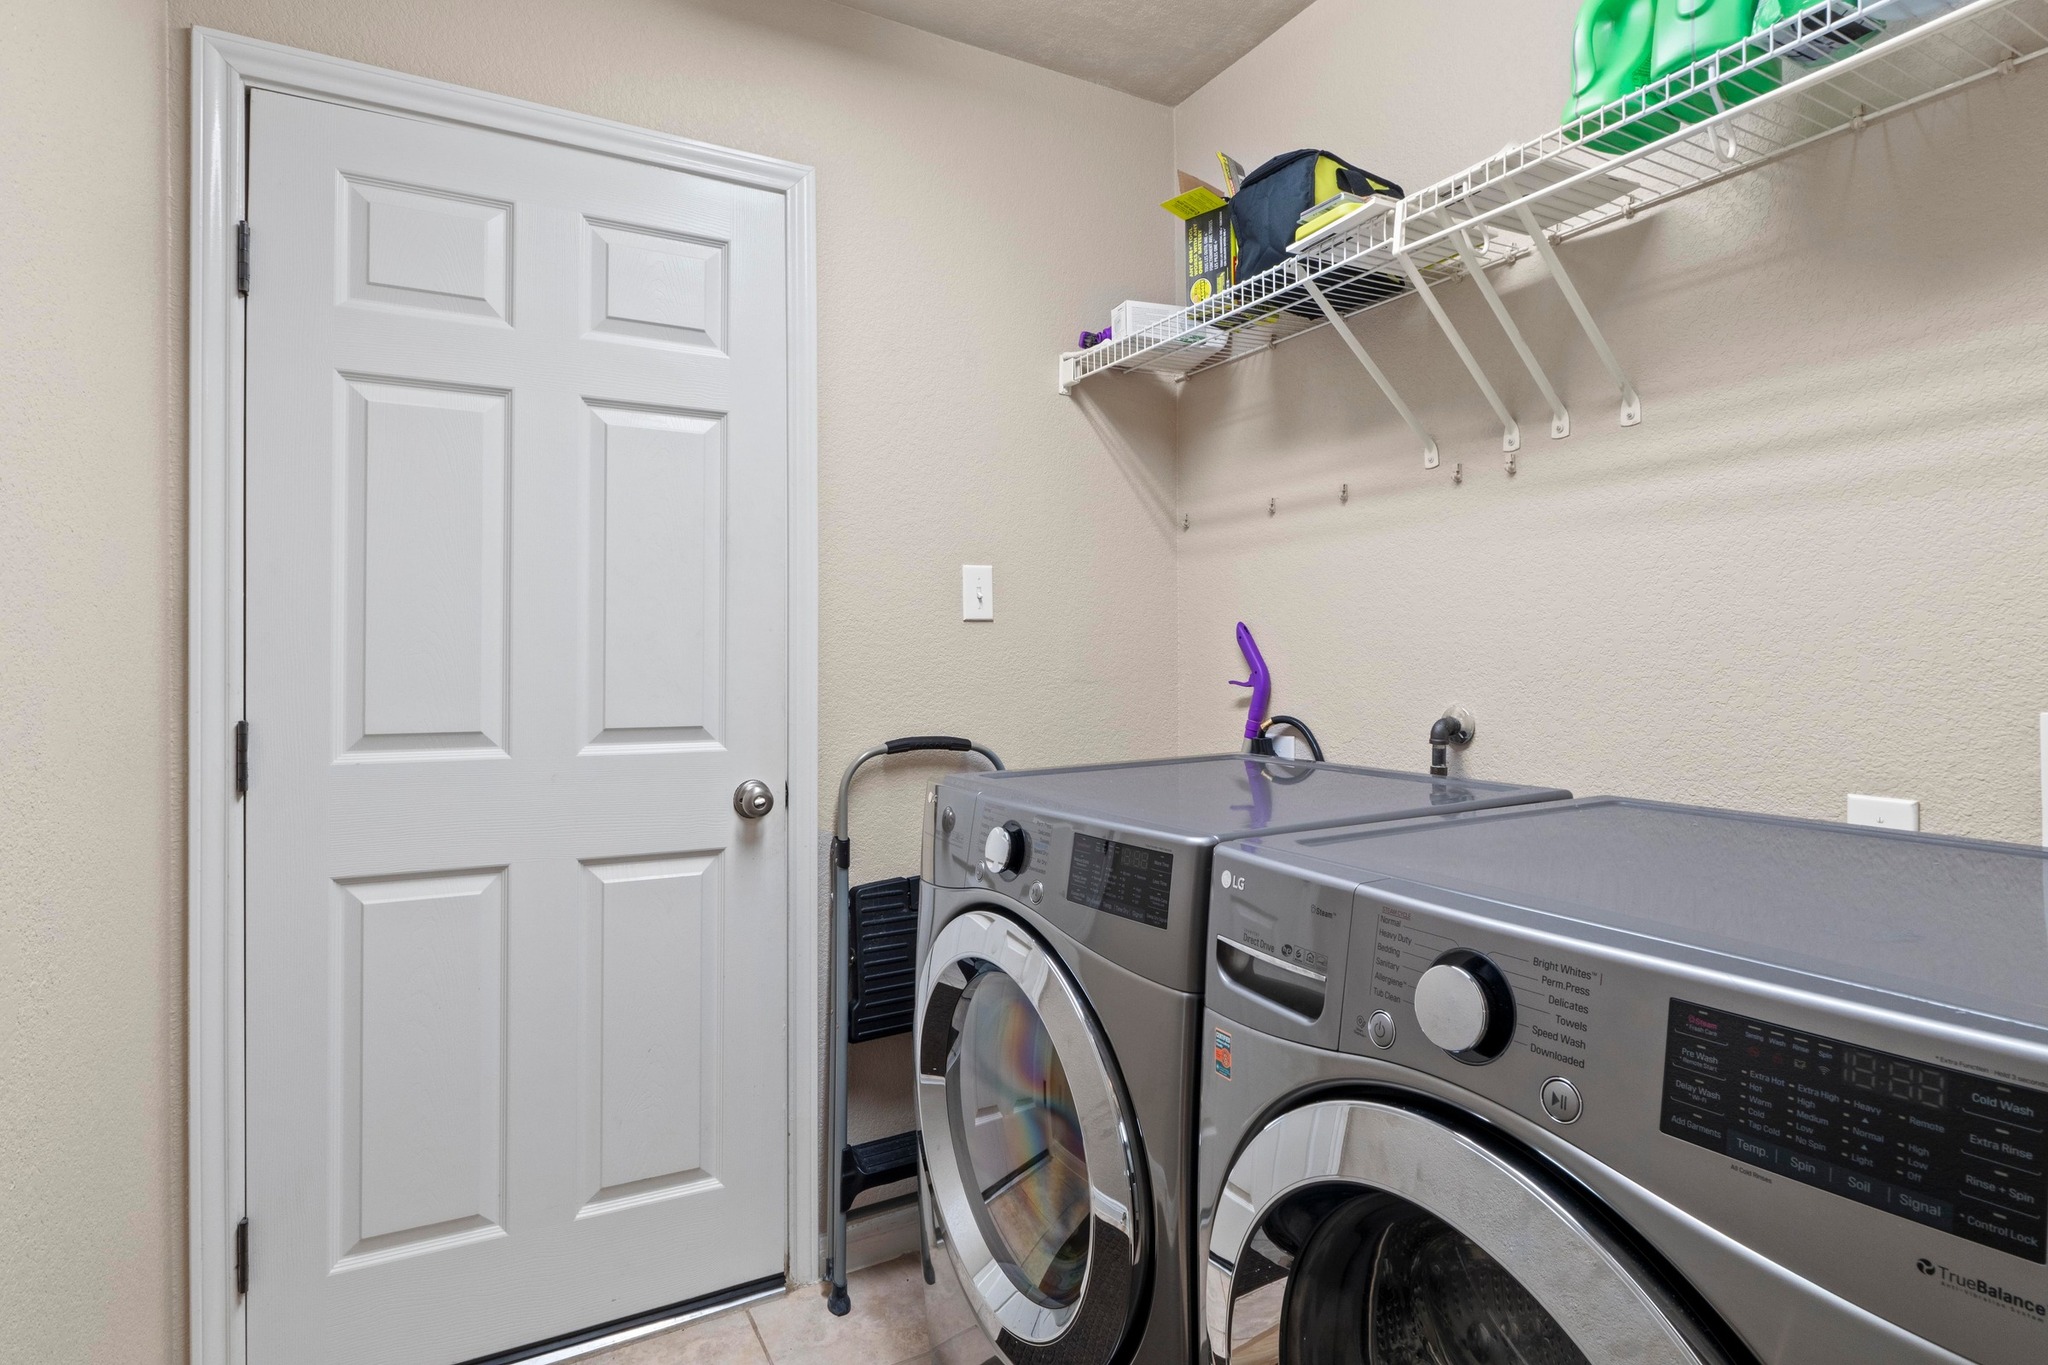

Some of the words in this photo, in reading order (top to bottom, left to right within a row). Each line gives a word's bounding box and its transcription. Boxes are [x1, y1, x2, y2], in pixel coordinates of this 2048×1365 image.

[1232, 875, 1245, 890] LG
[1381, 916, 1401, 927] Normal
[1243, 932, 1259, 946] Direct
[1260, 938, 1275, 953] Drive
[1379, 928, 1397, 941] Heavy
[1398, 934, 1412, 946] Duty
[1377, 943, 1400, 958] Bedding
[1376, 957, 1399, 971] Sanitary
[1533, 957, 1559, 971] Bright
[1374, 987, 1383, 998] Tub
[1385, 991, 1400, 1003] Clean
[1548, 995, 1589, 1014] Delicates
[1556, 1014, 1587, 1032] Towels
[1532, 1025, 1558, 1041] Speed
[1560, 1034, 1586, 1050] Wash
[1530, 1043, 1585, 1068] Downloaded
[1682, 1047, 1694, 1058] Pre
[1696, 1052, 1719, 1064] Wash
[1818, 1050, 1833, 1059] Spin
[1750, 1070, 1770, 1082] Extra
[1771, 1077, 1786, 1087] Hot
[1676, 1080, 1696, 1092] Delay
[1698, 1088, 1721, 1100] Wash
[1749, 1083, 1763, 1093] Hot
[1798, 1084, 1820, 1097] Extra
[1821, 1091, 1840, 1103] High
[1749, 1096, 1772, 1109] Warm
[1797, 1097, 1816, 1109] High
[1854, 1100, 1882, 1116] Heavy
[1972, 1092, 1998, 1107] Cold
[1999, 1100, 2034, 1117] Wash
[1748, 1108, 1765, 1119] Cold
[1797, 1110, 1829, 1126] Medium
[1671, 1115, 1685, 1126] Add
[1687, 1120, 1722, 1139] Garments
[1749, 1120, 1762, 1131] Tap
[1764, 1125, 1780, 1136] Cold
[1796, 1122, 1814, 1134] Low
[1909, 1116, 1945, 1133] Remote
[1795, 1135, 1807, 1145] No
[1808, 1140, 1826, 1151] Spin
[1853, 1127, 1884, 1143] Normal
[1909, 1144, 1930, 1158] High
[1970, 1134, 1999, 1150] Extra
[2002, 1143, 2033, 1160] Rinse
[1851, 1153, 1874, 1168] Light
[1908, 1158, 1928, 1170] Low
[1737, 1138, 1768, 1158] Temp.
[1790, 1156, 1816, 1174] Spin
[1848, 1176, 1870, 1193] Soil
[1899, 1193, 1941, 1217] Signal
[1907, 1172, 1922, 1182] Off
[1965, 1174, 1996, 1192] Rinse
[2009, 1188, 2035, 1204] Spin
[1967, 1216, 2008, 1237] Control
[2010, 1230, 2038, 1247] Lock
[1938, 1264, 2046, 1316] TrueBalance
